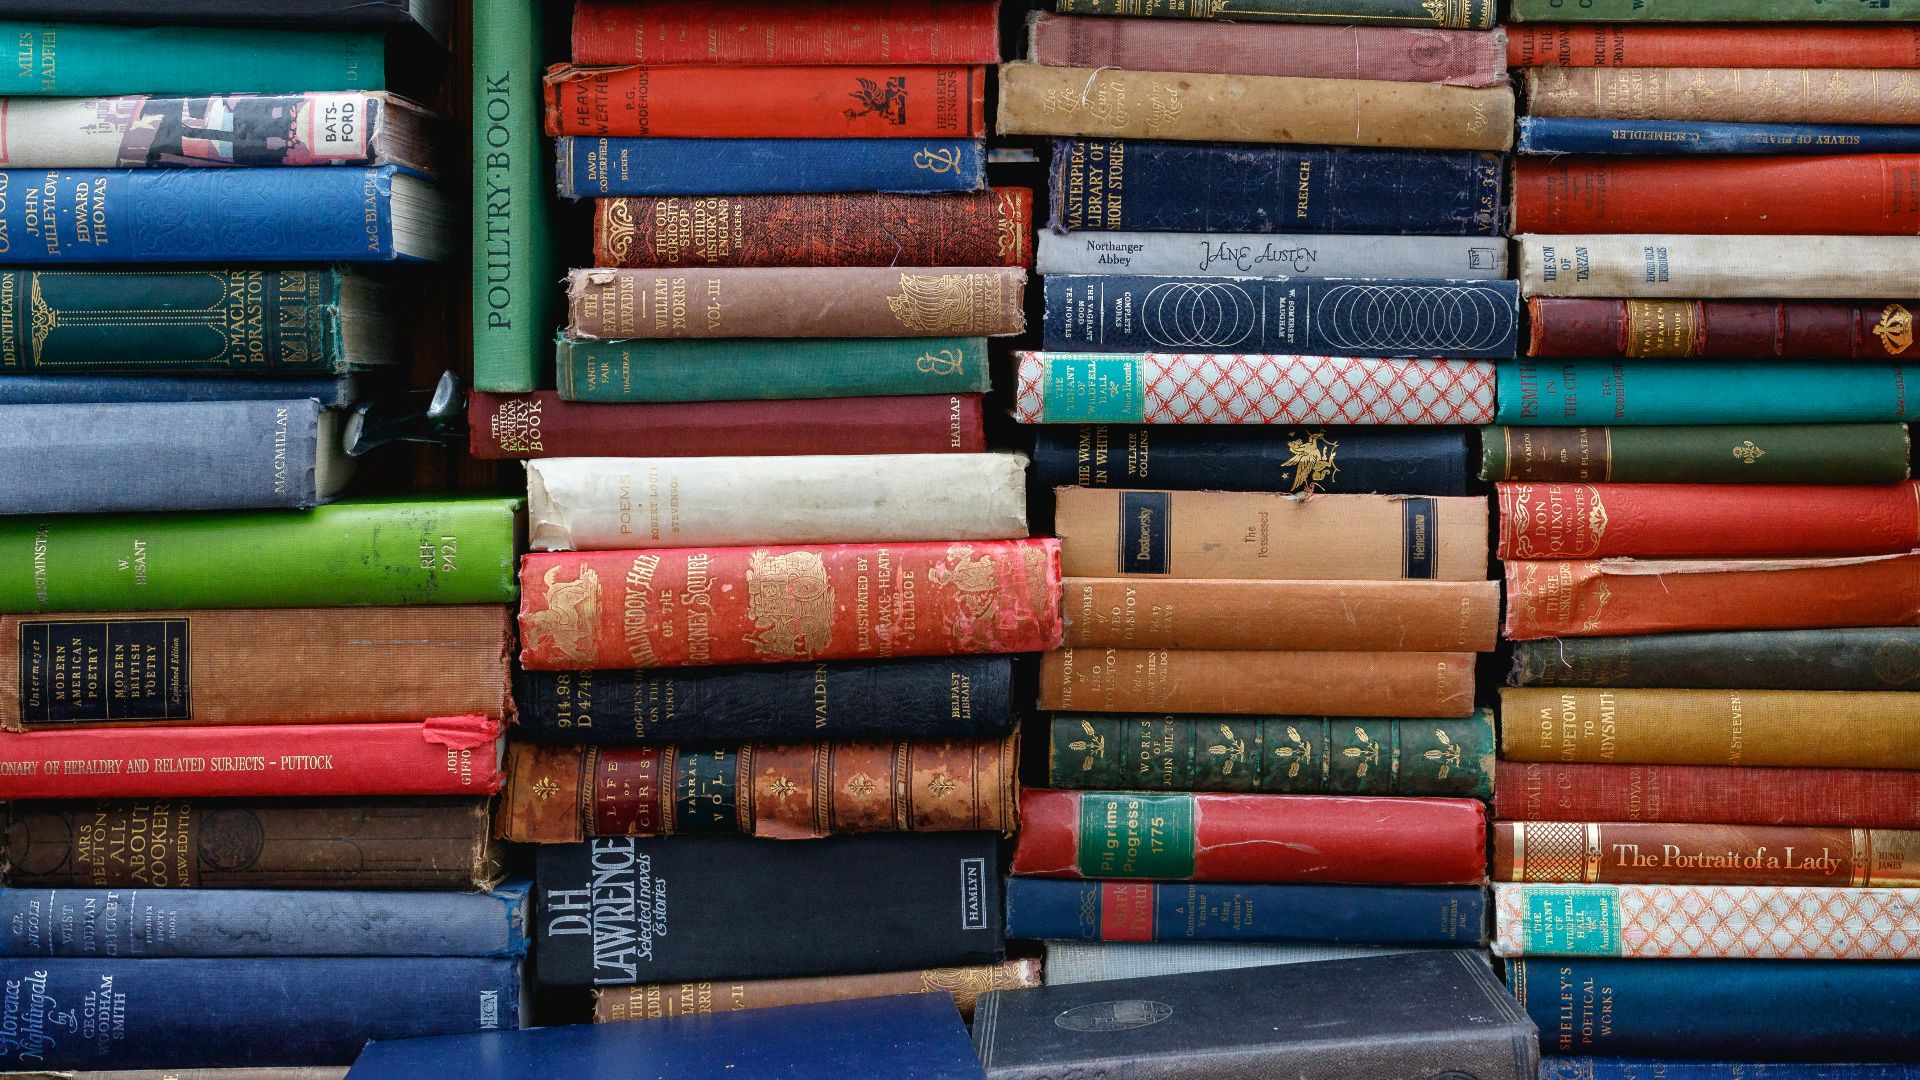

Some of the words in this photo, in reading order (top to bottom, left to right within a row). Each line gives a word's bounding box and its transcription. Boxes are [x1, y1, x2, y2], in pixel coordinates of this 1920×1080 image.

[19, 32, 33, 78] MILES
[627, 85, 637, 110] P.G.
[638, 66, 650, 135] WODEHOUSE
[948, 69, 958, 130] JENKINS
[1058, 88, 1080, 119] Life
[1163, 83, 1182, 123] Reed
[325, 102, 338, 142] BATS-
[342, 103, 355, 142] FORD
[1612, 131, 1687, 141] SCHMEIDLER
[1816, 135, 1861, 145] SURVEY
[588, 151, 597, 180] DAVID
[599, 139, 608, 193] COPPERFIELD
[26, 188, 39, 236] JOHN
[94, 178, 109, 246] THOMAS
[1089, 167, 1104, 227] LIBRARY
[1107, 193, 1122, 231] SHORT
[1297, 160, 1310, 219] FRENCH
[76, 183, 91, 243] EDWARD
[657, 202, 667, 226] OLD
[669, 196, 679, 263] CURIOSITY
[681, 210, 690, 246] SHOP
[694, 201, 705, 245] CHILD'S
[719, 200, 729, 257] ENGLAND
[735, 205, 743, 248] DICKENS
[657, 230, 667, 254] THE
[708, 215, 718, 263] HISTORY
[1087, 240, 1144, 254] Northanger
[1098, 254, 1132, 267] Abbey
[1543, 246, 1556, 263] SON
[1543, 264, 1556, 282] THE
[1561, 258, 1571, 270] OF
[1576, 246, 1589, 282] TARZAN
[2, 272, 16, 366] IDENTIFICATION
[248, 270, 264, 362] BORASTON
[584, 293, 597, 318] THE
[622, 276, 635, 332] PARADISE
[656, 278, 668, 329] WILLIAM
[673, 277, 686, 328] MORRIS
[1086, 303, 1094, 341] VAGRANT
[1115, 298, 1123, 328] WORKS
[1124, 291, 1132, 333] COMPLETE
[1278, 297, 1286, 338] MAUGHAM
[1287, 300, 1296, 343] SOMERSET
[588, 354, 597, 391] VANITY
[602, 362, 610, 384] FAIR
[1099, 375, 1107, 403] HALL
[492, 415, 500, 438] THE
[500, 403, 509, 451] ARTHUR
[508, 400, 518, 450] RACKHAM
[516, 399, 530, 451] FAIRY
[529, 400, 543, 452] BOOK
[950, 397, 961, 447] HARRAP
[1564, 393, 1577, 418] THE
[275, 408, 287, 494] MACMILLAN
[1129, 433, 1137, 475] WILKIE
[1139, 430, 1149, 477] COLLINS
[620, 474, 632, 534] POEMS
[650, 503, 659, 541] ROBERT
[1535, 501, 1549, 537] DON
[1549, 486, 1565, 551] QUIXOTE
[1576, 488, 1586, 551] CERVANTES
[1136, 507, 1153, 560] Dostoevsky
[1245, 526, 1256, 544] The
[1259, 511, 1269, 558] Possessed
[1413, 515, 1425, 560] Heinemann
[624, 554, 661, 588] HALL
[680, 554, 716, 611] SQUIRE
[856, 558, 868, 570] BY
[857, 573, 868, 651] ILLUSTRATED
[1547, 575, 1560, 615] THREE
[31, 640, 42, 707] Untermeyer
[56, 646, 65, 700] MODERN
[72, 638, 81, 707] AMERICAN
[88, 646, 97, 698] POETRY
[115, 644, 124, 698] MODERN
[130, 644, 140, 698] BRITISH
[146, 644, 156, 696] POETRY
[169, 638, 179, 663] Edition
[816, 663, 828, 728] WALDEN
[951, 674, 961, 718] BELFAST
[962, 675, 971, 719] LIBRARY
[1141, 721, 1150, 772] WORKS
[1153, 741, 1160, 754] OF
[1540, 707, 1553, 749] FROM
[1585, 720, 1595, 737] TO
[44, 761, 59, 775] OF
[64, 760, 121, 774] HERALDRY
[128, 760, 149, 772] AND
[154, 758, 205, 772] RELATED
[211, 757, 264, 770] SUBJECTS
[281, 756, 333, 769] PUTTOCK
[607, 762, 616, 815] LIFE
[639, 746, 652, 827] CHRIST
[1164, 758, 1174, 785] JOHN
[710, 770, 722, 820] VOL.
[79, 824, 91, 861] MRS
[110, 820, 125, 863] ALL
[1101, 801, 1120, 871] Pilgrims
[1122, 801, 1141, 873] Progress
[1151, 817, 1164, 854] 1775
[1878, 851, 1905, 860] HENRY
[636, 853, 652, 899] novels
[1613, 844, 1658, 867] The
[1664, 845, 1741, 869] Portrait
[1744, 848, 1768, 869] of
[1768, 857, 1779, 870] a
[1784, 847, 1841, 876] Lady
[1878, 861, 1903, 870] JAMES
[548, 882, 592, 937] D.H.
[593, 837, 637, 984] LAWRENCE
[968, 867, 979, 920] HAMLYN
[1110, 885, 1128, 930] Mark
[1128, 884, 1149, 934] Twain
[27, 900, 40, 948] NICOLE
[63, 905, 74, 944] WEST
[85, 898, 97, 951] INDIAN
[106, 892, 119, 955] CRICKET
[636, 903, 653, 961] Selected
[1534, 912, 1543, 932] THE
[1544, 900, 1554, 946] TENANT
[1565, 895, 1576, 949] WILDFELL
[1577, 911, 1587, 938] HALL
[20, 970, 56, 1061] Nightingale
[84, 991, 95, 1038] CECIL
[99, 975, 113, 1055] WOODHAM
[114, 993, 126, 1039] SMITH
[484, 995, 495, 1022] BCA
[1560, 967, 1572, 1049] SHELLEY'S
[1583, 977, 1594, 1044] POETICAL
[1602, 987, 1612, 1036] WORKS
